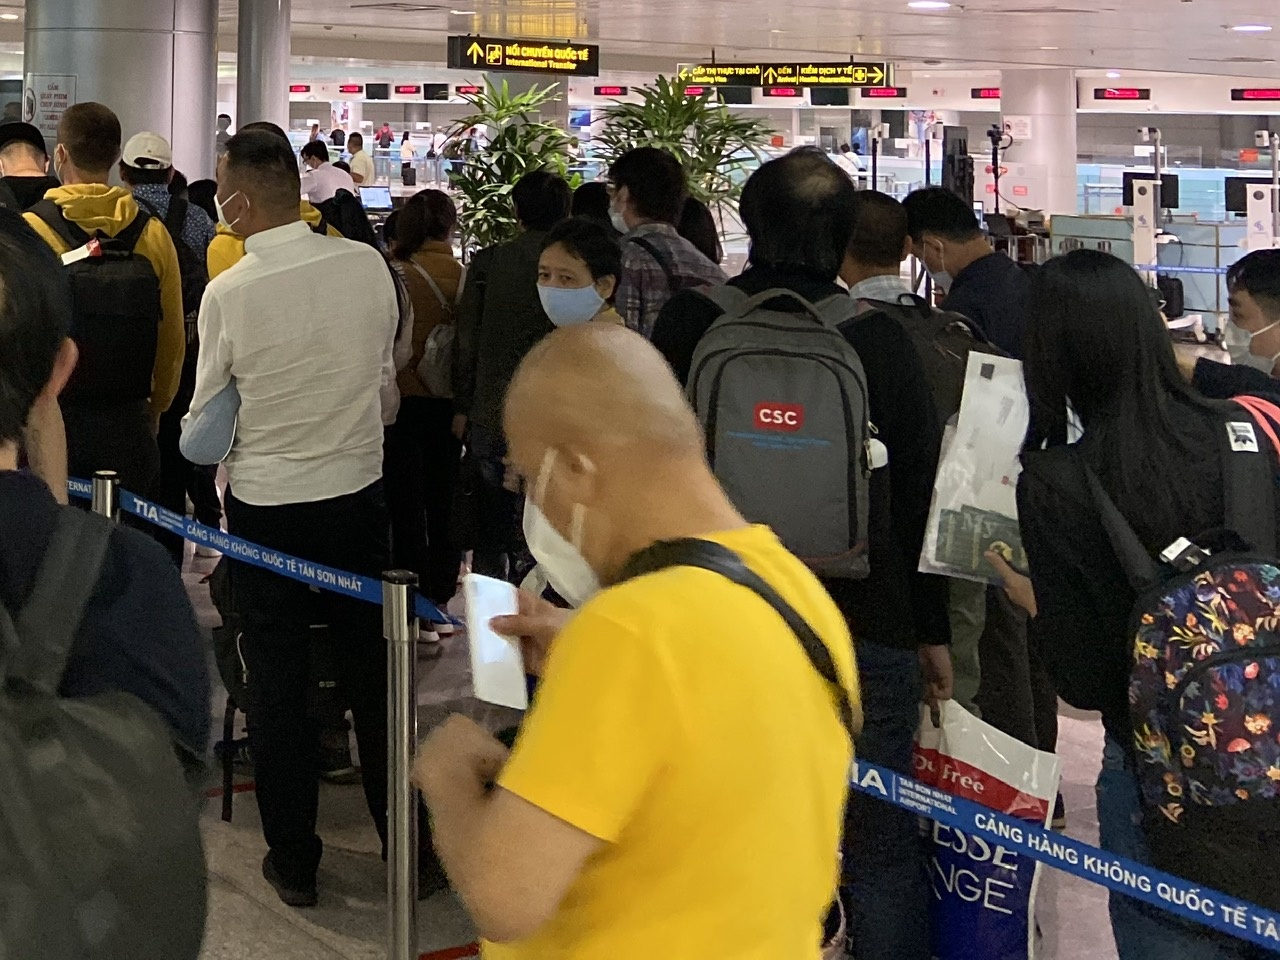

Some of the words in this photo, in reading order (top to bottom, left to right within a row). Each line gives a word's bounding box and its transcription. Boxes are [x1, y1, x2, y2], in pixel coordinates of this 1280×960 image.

[506, 43, 520, 56] NỐI
[554, 47, 577, 60] QUỐC
[577, 48, 589, 60] TẾ
[506, 58, 548, 68] International
[548, 60, 577, 70] Transfer
[760, 408, 797, 425] CSC
[133, 497, 159, 522] TIA
[231, 542, 260, 559] KHÔNG
[261, 552, 284, 568] QUỐC
[286, 559, 297, 572] TẾ
[299, 563, 315, 579] TÂN
[316, 569, 336, 585] SƠN
[338, 576, 363, 593] NHẤT
[851, 762, 888, 796] IA
[942, 764, 985, 795] Free
[898, 786, 958, 815] INTERNATIONAL
[900, 797, 932, 814] AIRPORT
[975, 812, 1024, 843] CẢNG
[1028, 833, 1079, 864] HÀNG
[1083, 854, 1152, 892] KHÔNG
[1156, 882, 1215, 917] QUỐC
[1220, 904, 1248, 930] TẾ
[1252, 916, 1280, 941] TÂ
